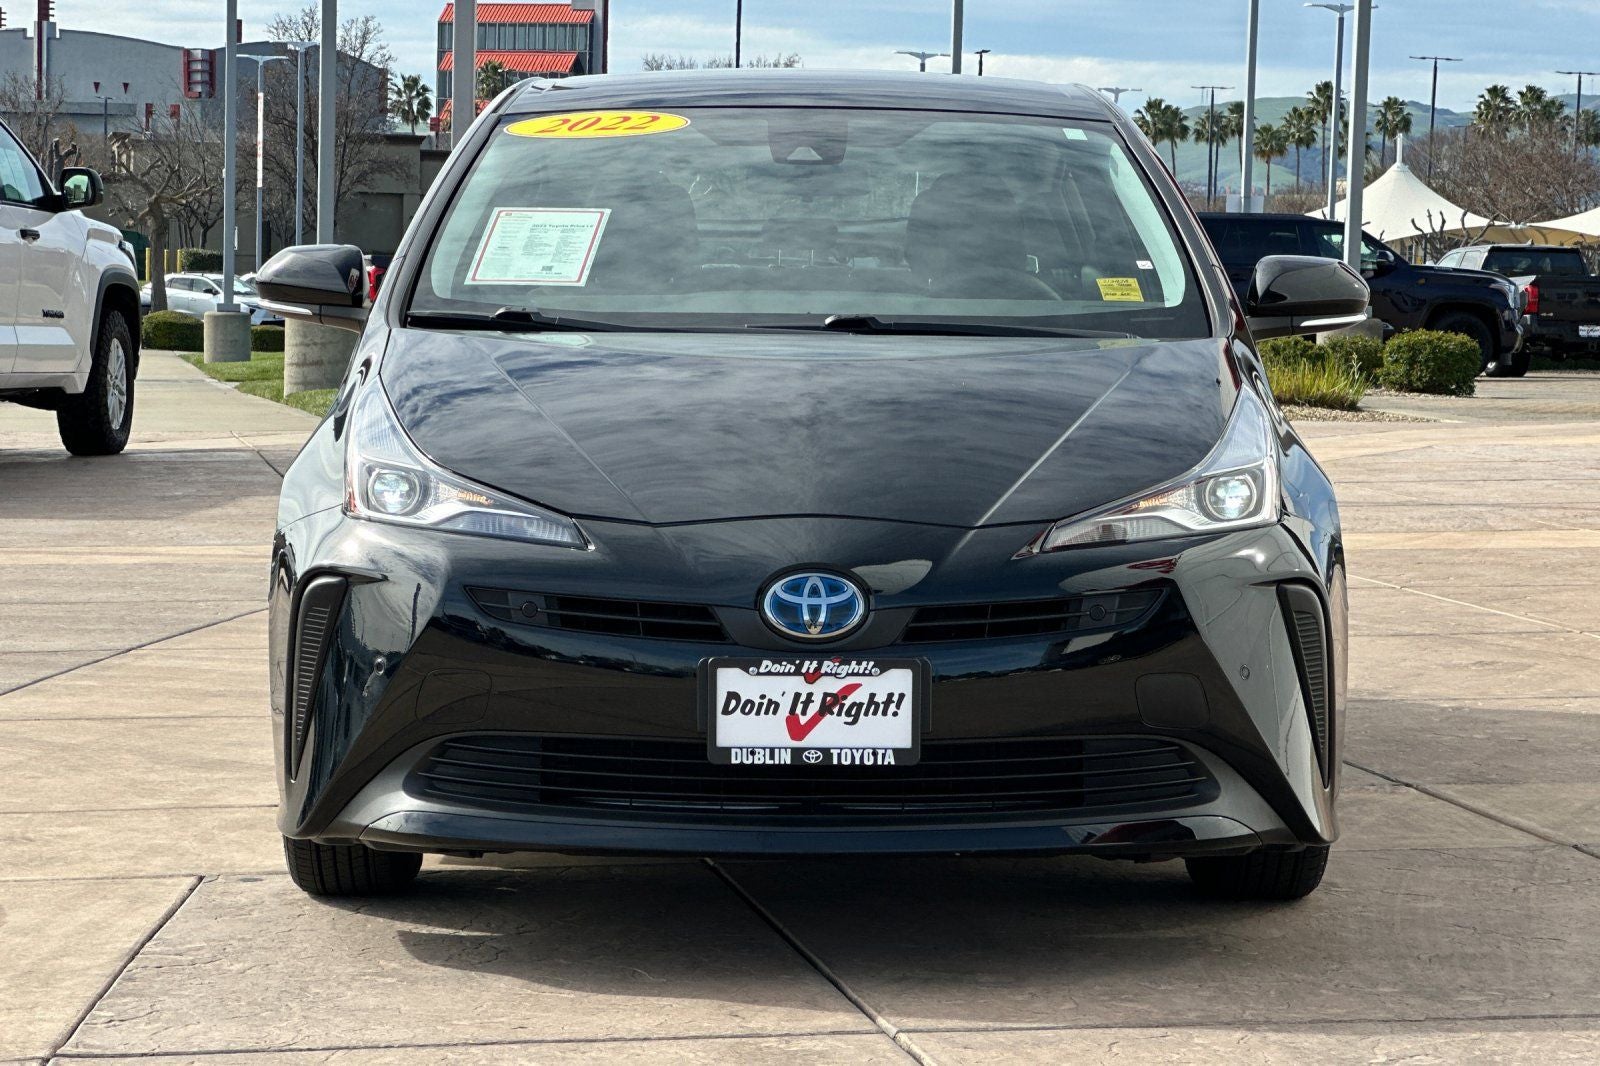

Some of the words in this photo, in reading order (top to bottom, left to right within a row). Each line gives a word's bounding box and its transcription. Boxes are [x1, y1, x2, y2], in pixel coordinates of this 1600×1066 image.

[535, 116, 660, 133] 2022
[759, 660, 800, 674] Doin'
[801, 661, 820, 674] It
[820, 660, 874, 679] Right!
[721, 690, 786, 717] Doin'
[788, 691, 815, 717] It
[818, 691, 906, 726] Right!
[731, 748, 791, 764] DUBLIN
[830, 749, 895, 765] TOYOTA
